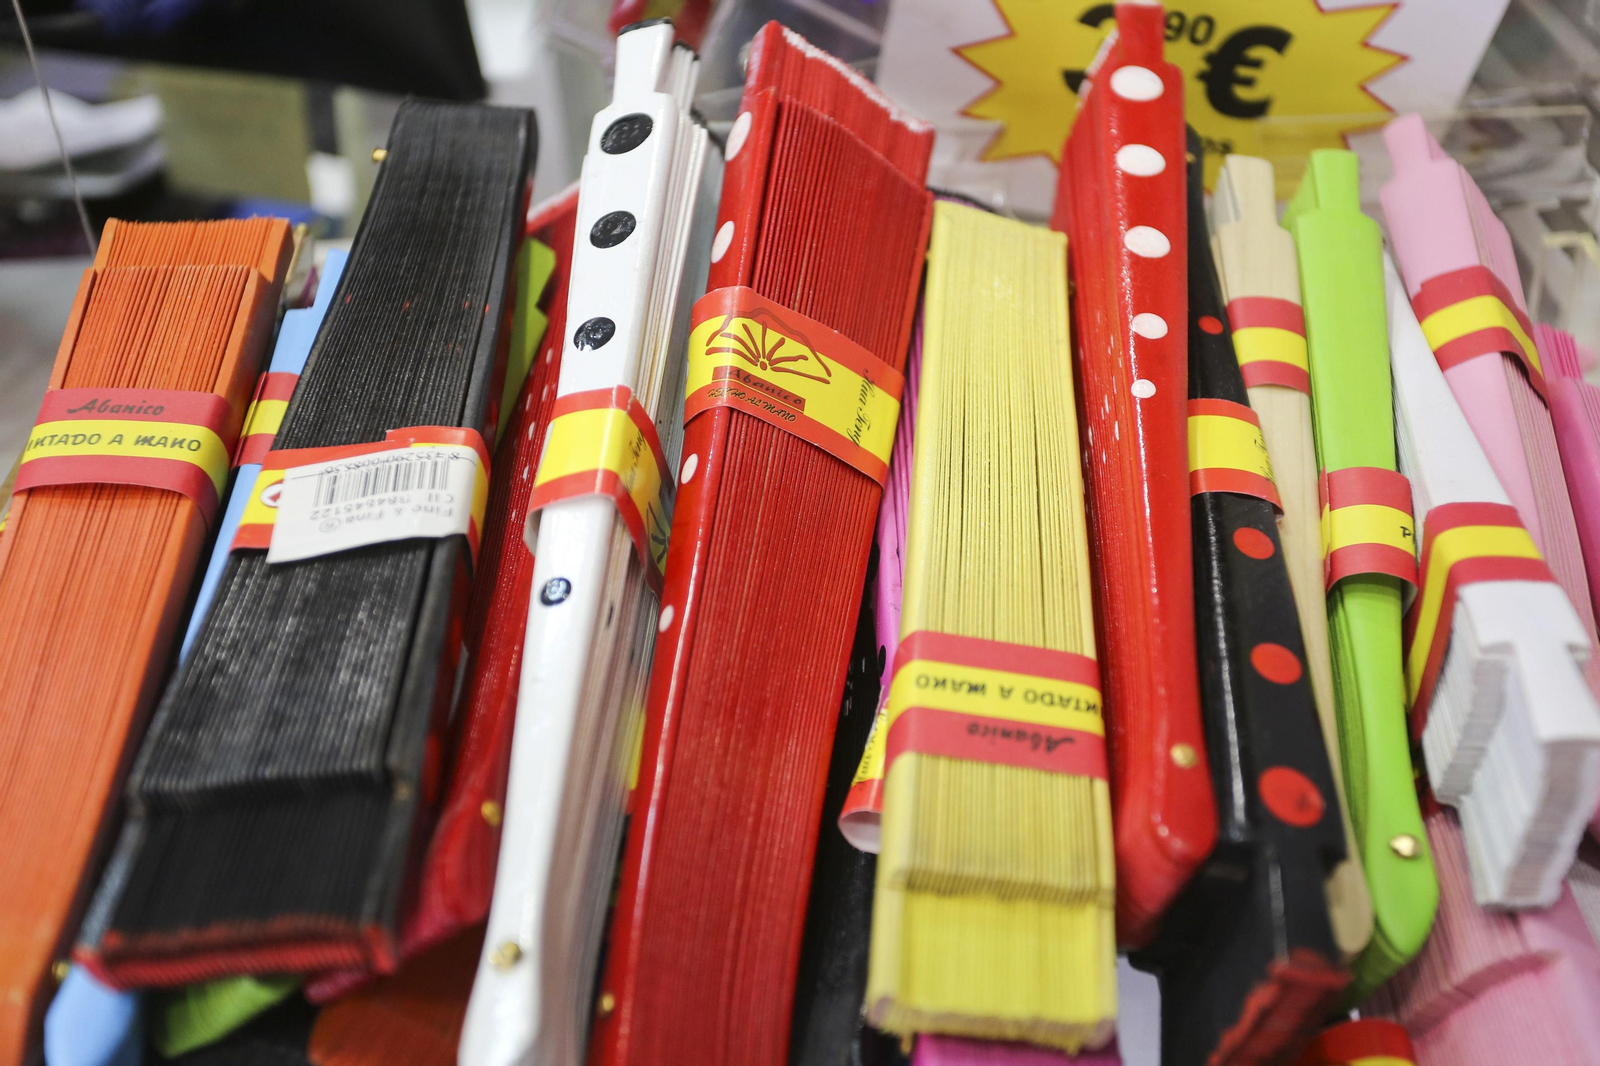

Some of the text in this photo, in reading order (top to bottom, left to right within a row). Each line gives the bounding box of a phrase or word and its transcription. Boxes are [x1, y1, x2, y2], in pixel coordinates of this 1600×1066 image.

[725, 369, 803, 405] Abanico
[66, 399, 165, 416] Abanico
[763, 401, 797, 423] MANO
[107, 433, 124, 446] A
[999, 686, 1014, 699] A
[966, 721, 1075, 753] Abanico
